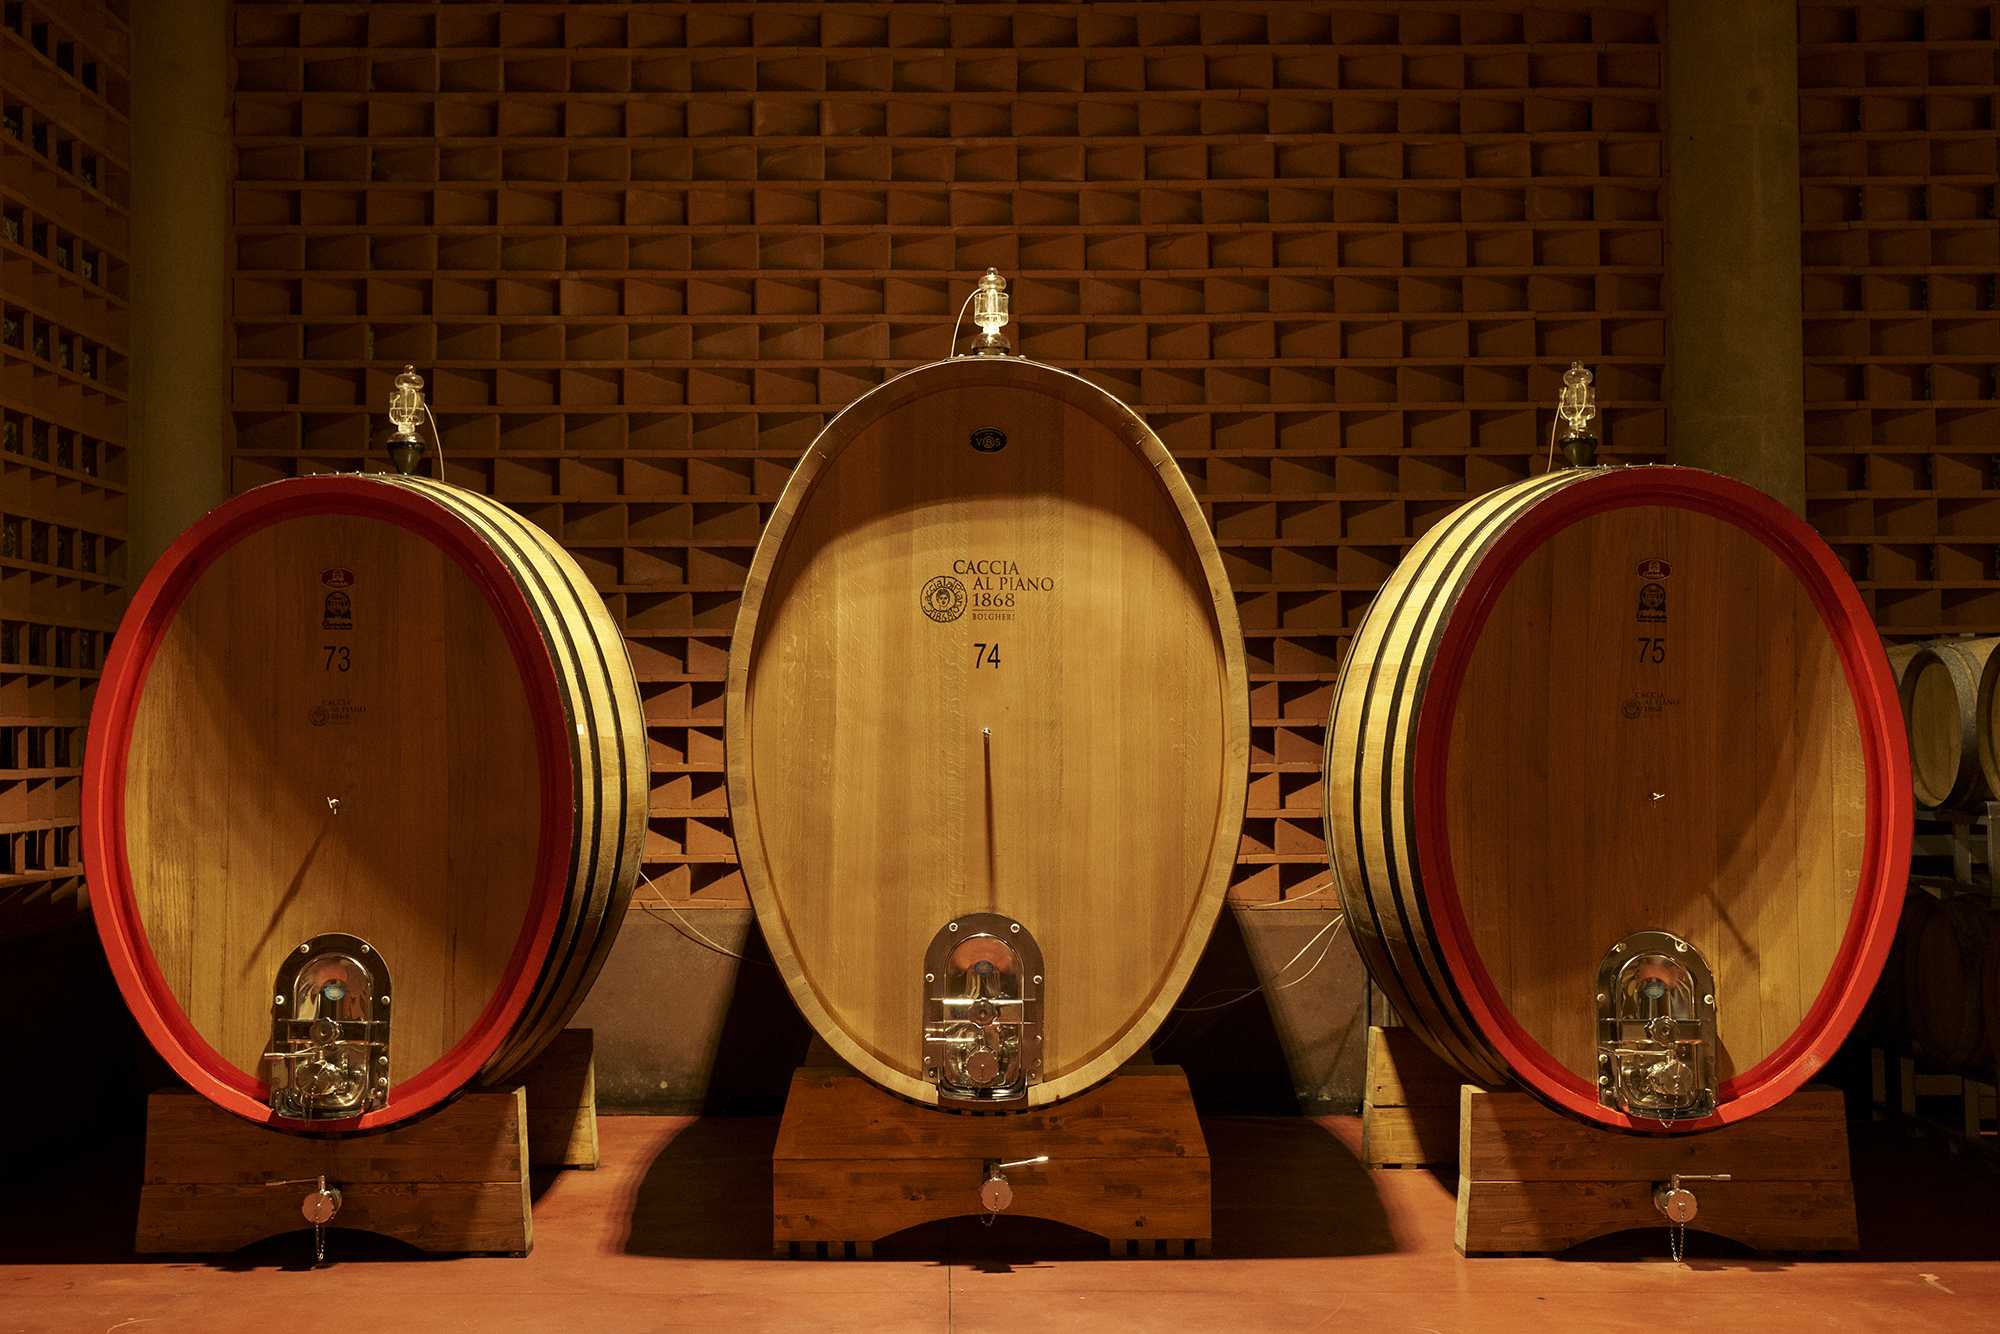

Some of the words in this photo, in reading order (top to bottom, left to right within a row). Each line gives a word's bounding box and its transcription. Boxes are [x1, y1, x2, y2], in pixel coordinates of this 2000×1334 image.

[952, 559, 1020, 575] CACCIA
[973, 577, 993, 591] AL
[999, 577, 1055, 592] PIANO
[972, 592, 1016, 608] 1868
[323, 646, 351, 672] 73
[973, 643, 1001, 670] 74
[1637, 637, 1665, 664] 75
